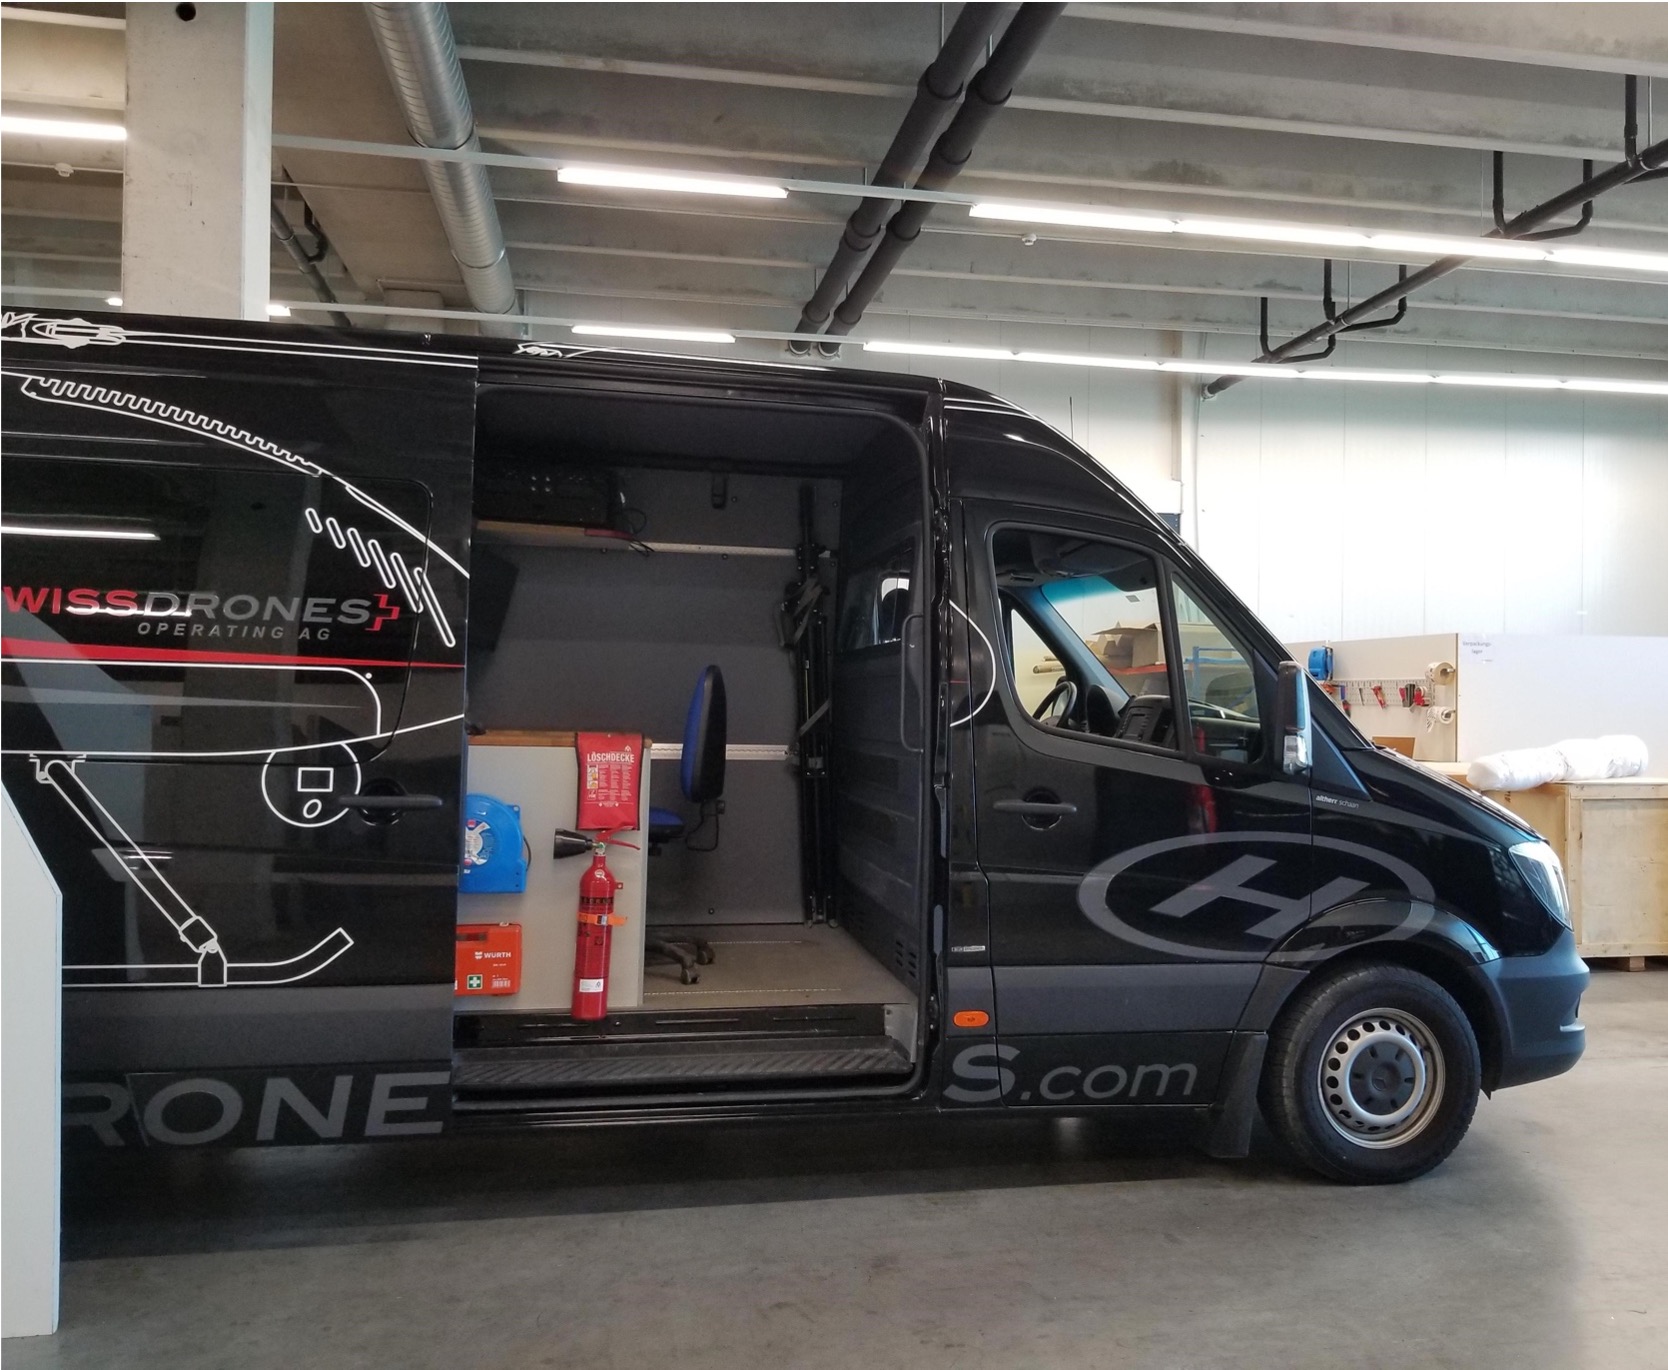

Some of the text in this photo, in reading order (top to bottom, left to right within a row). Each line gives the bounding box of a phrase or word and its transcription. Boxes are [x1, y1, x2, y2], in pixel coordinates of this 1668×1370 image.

[137, 622, 330, 641] OPERATING AG
[587, 751, 635, 763] LÖSCHDECKE
[943, 1043, 1198, 1102] S.com
